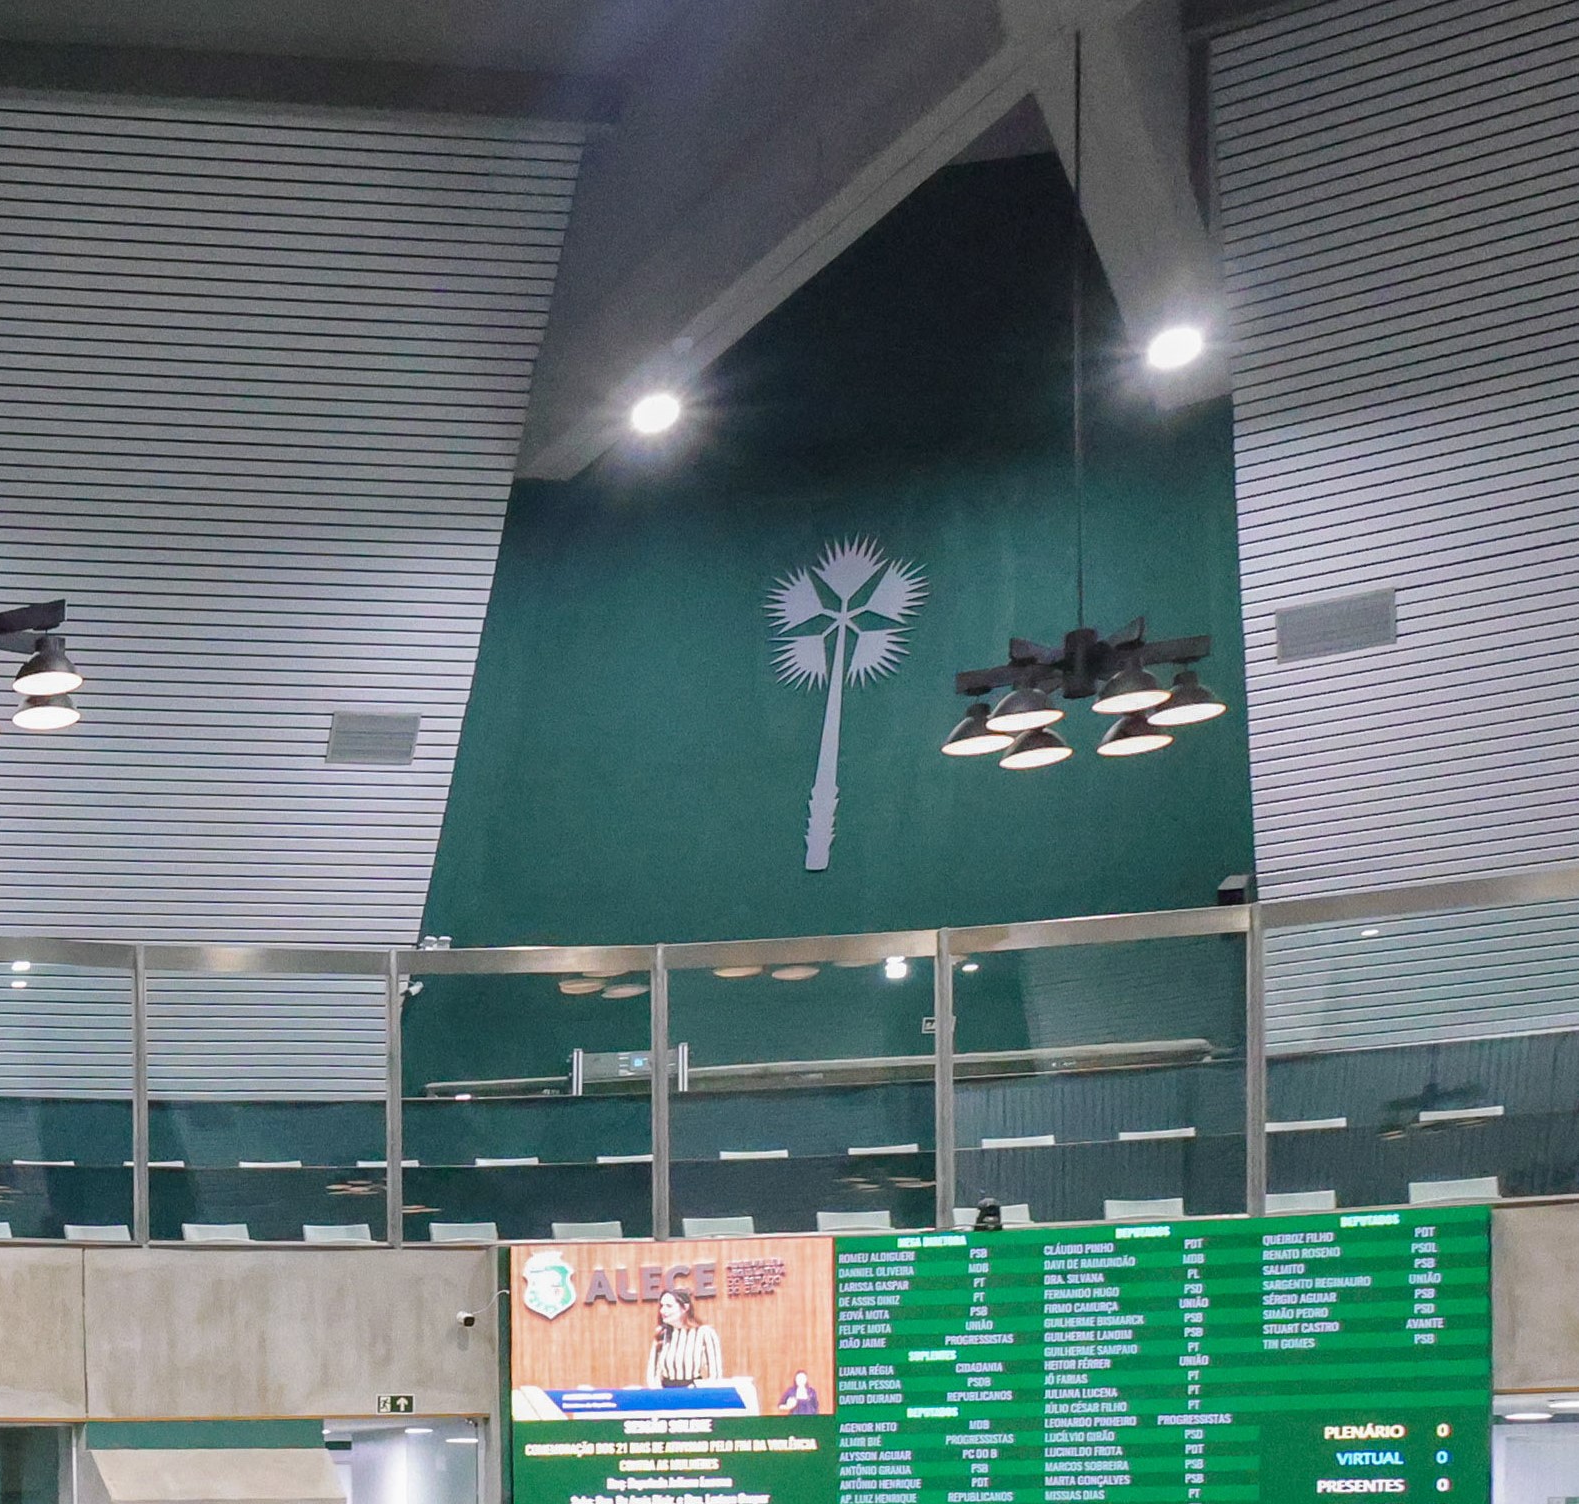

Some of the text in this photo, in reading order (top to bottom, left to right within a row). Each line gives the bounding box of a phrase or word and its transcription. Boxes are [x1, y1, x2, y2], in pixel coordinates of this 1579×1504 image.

[1324, 1423, 1450, 1439] PLENÁRIO 0
[1336, 1451, 1448, 1465] VIRTUAL 0
[1317, 1479, 1450, 1493] PRESENTES 0
